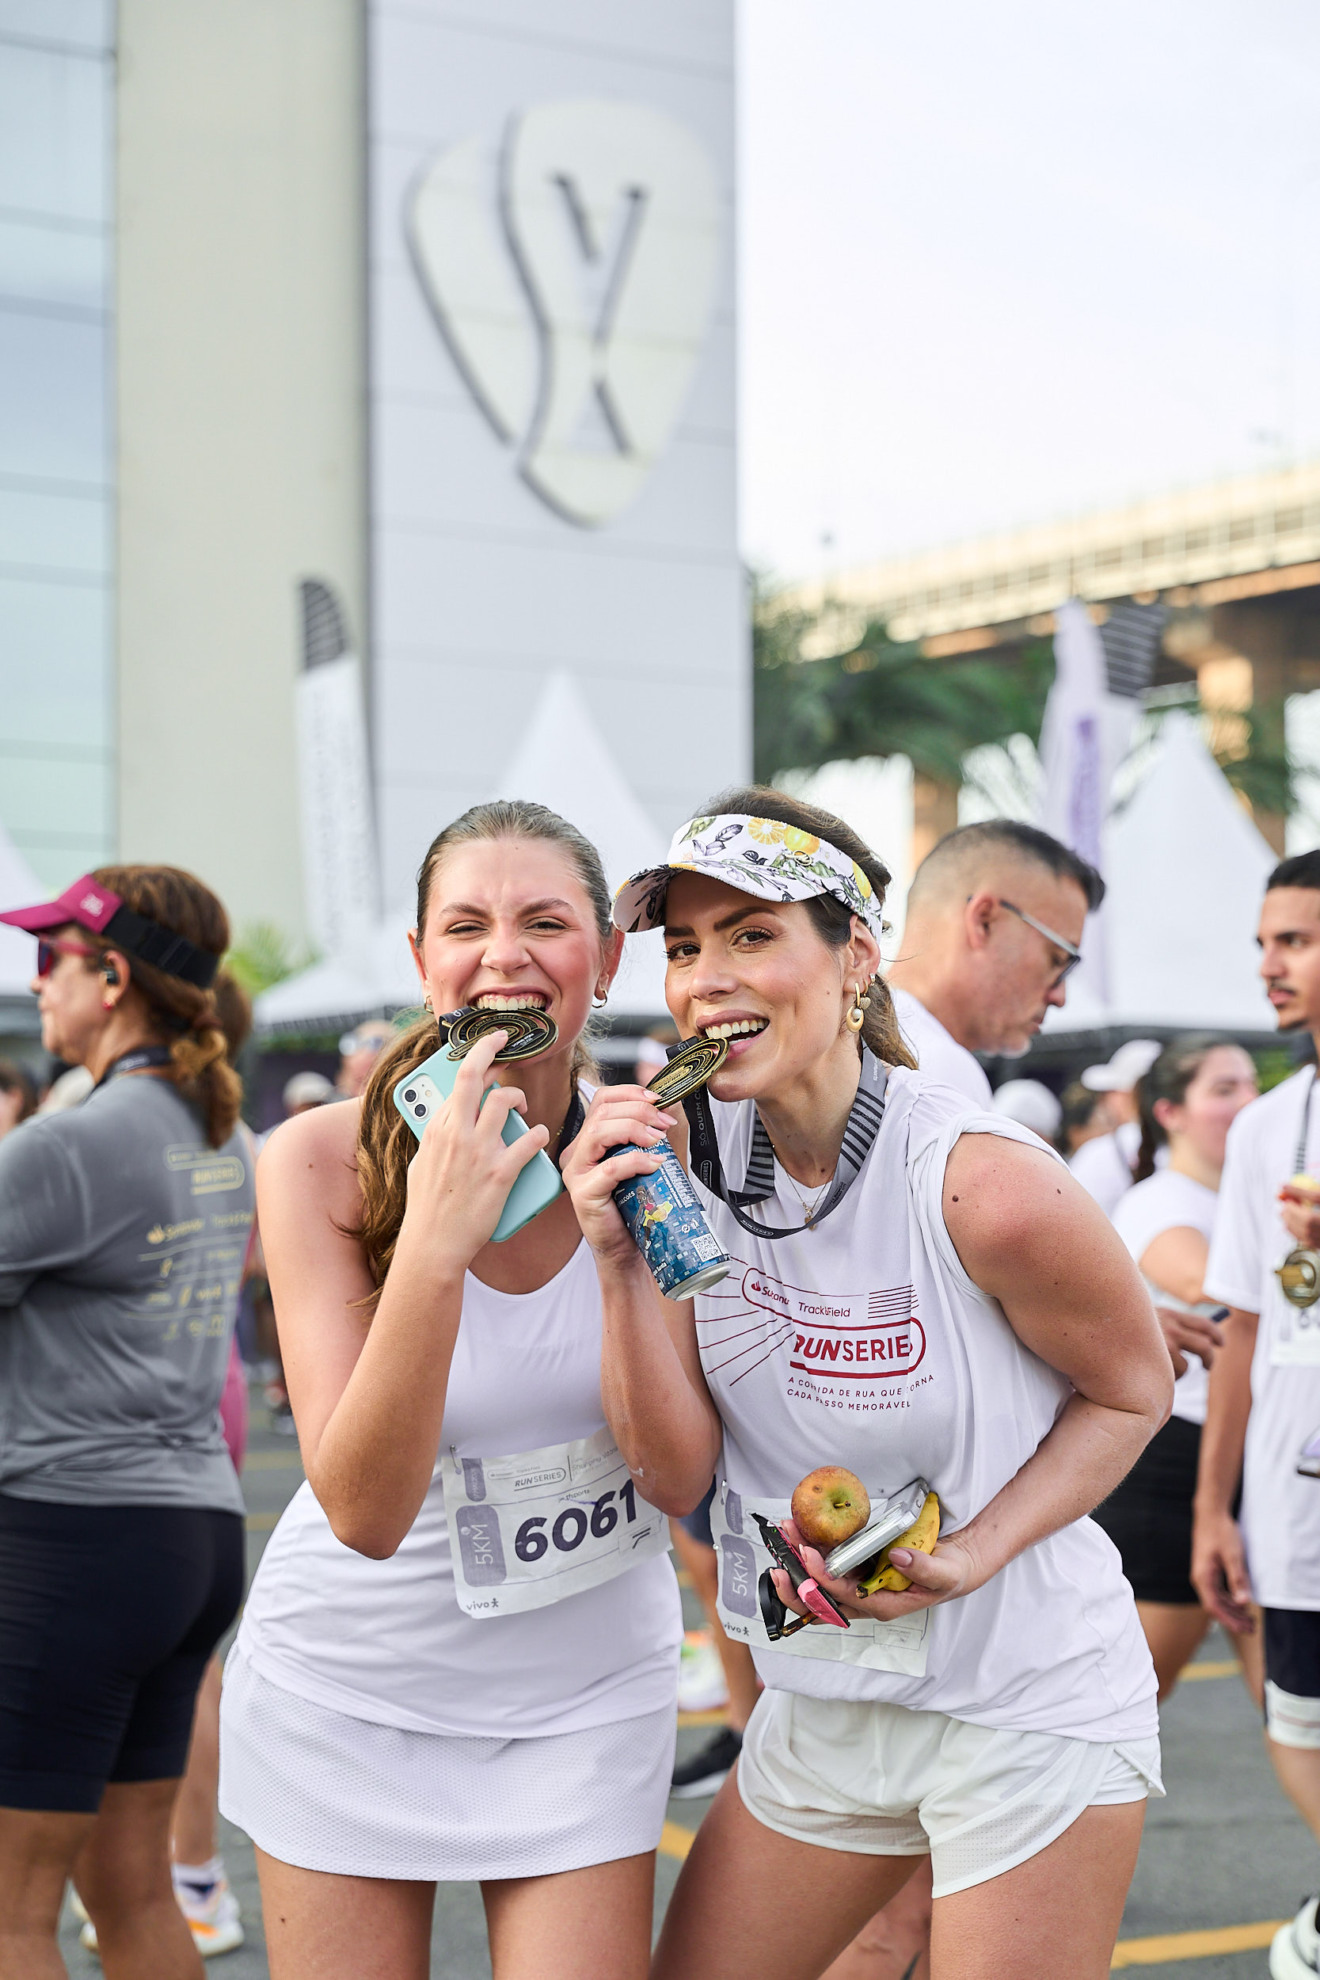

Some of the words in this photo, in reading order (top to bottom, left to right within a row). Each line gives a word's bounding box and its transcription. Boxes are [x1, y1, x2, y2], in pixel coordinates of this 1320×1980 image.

[696, 1102, 705, 1131] QUEM
[793, 1334, 913, 1362] RUNSERIE
[787, 1376, 795, 1384] A
[839, 1389, 850, 1397] DE
[856, 1390, 875, 1398] RUA
[881, 1388, 902, 1397] QUE
[907, 1374, 934, 1393] ORNA
[787, 1388, 812, 1401] CADA
[848, 1400, 911, 1411] MEMORÁVEL
[514, 1478, 637, 1563] 6061
[470, 1524, 494, 1565] 5KM
[732, 1551, 749, 1597] 5KM
[466, 1601, 490, 1610] vivo
